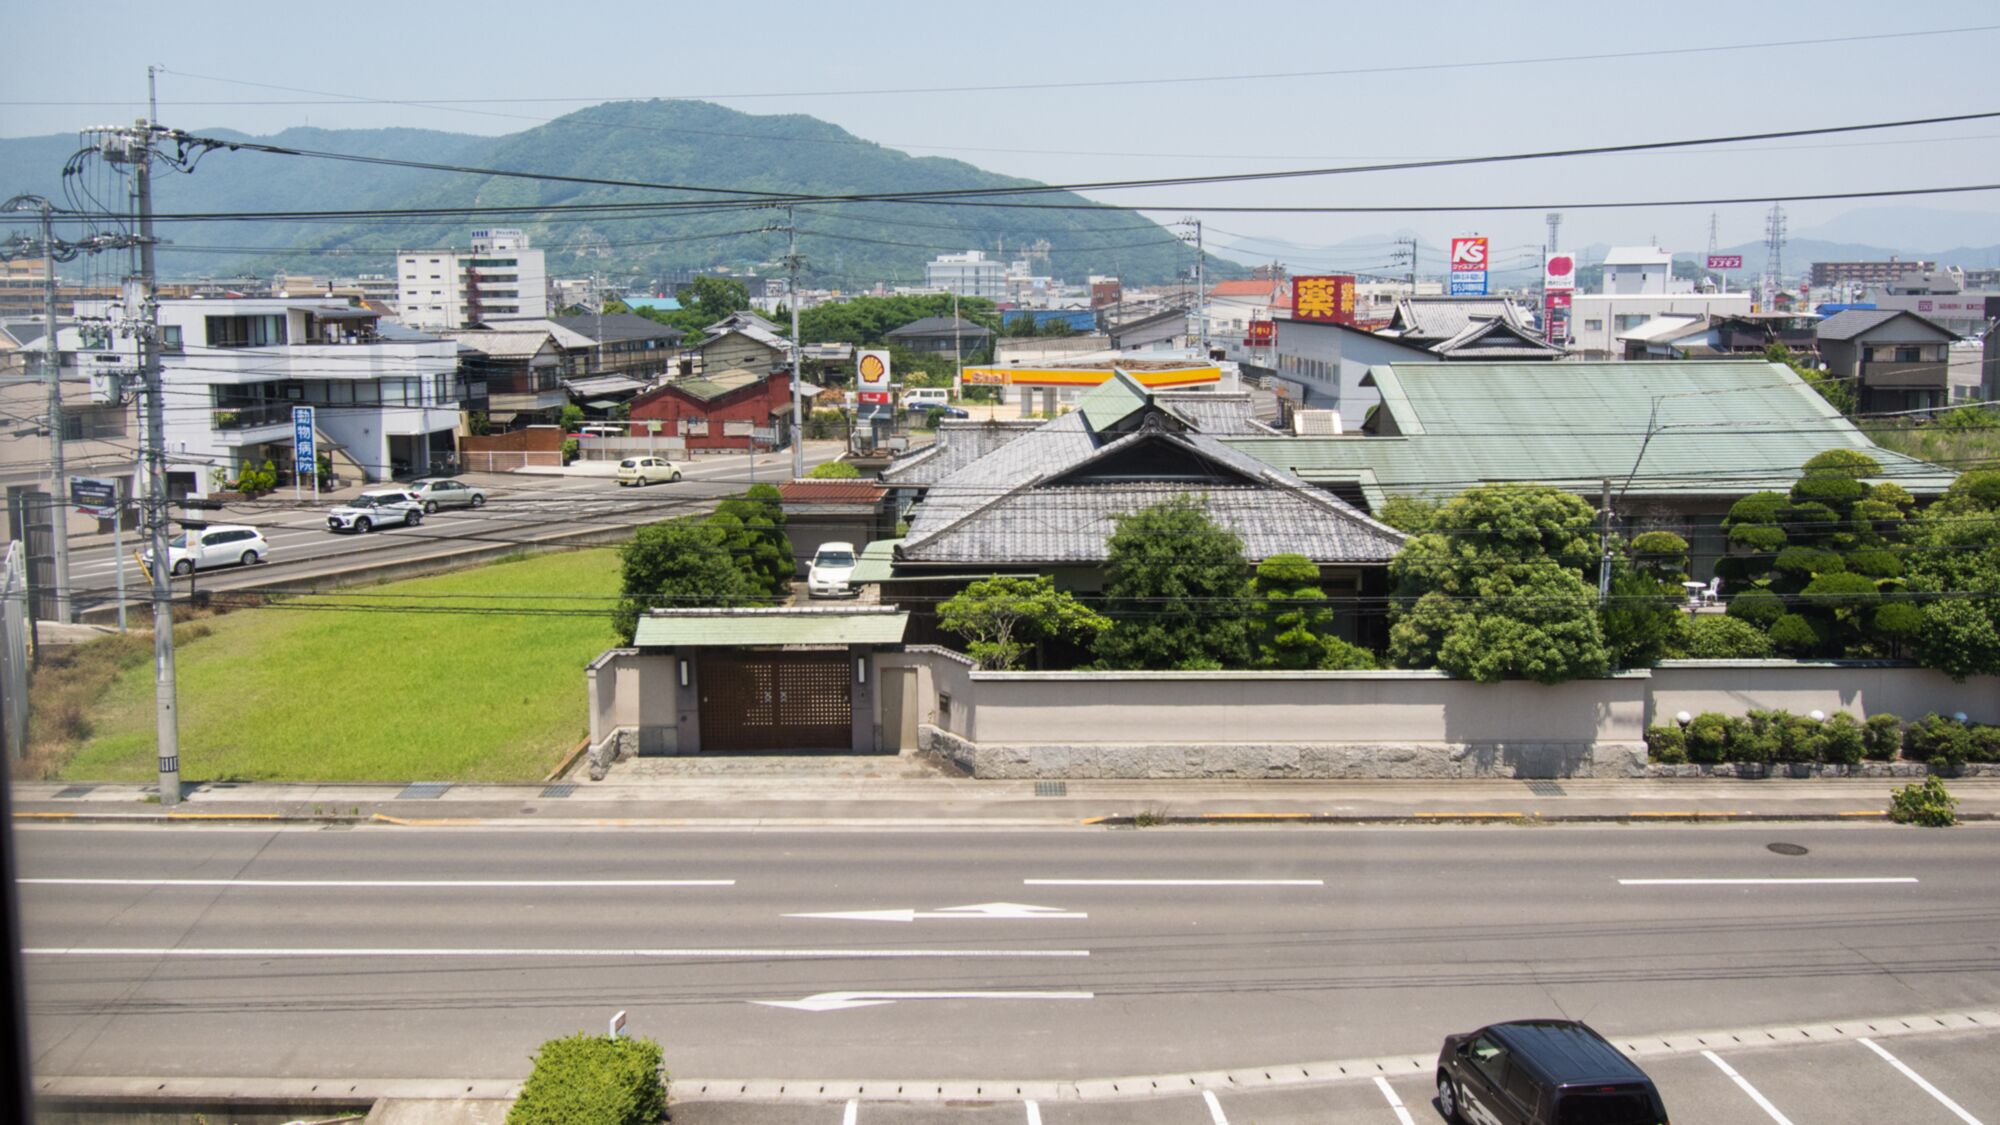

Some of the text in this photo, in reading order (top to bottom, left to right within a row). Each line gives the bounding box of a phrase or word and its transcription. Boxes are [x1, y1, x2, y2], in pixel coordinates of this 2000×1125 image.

[1298, 278, 1335, 317] 薬
[1341, 282, 1354, 313] 薬
[972, 371, 1010, 384] Shell
[297, 409, 313, 472] 動物病院
